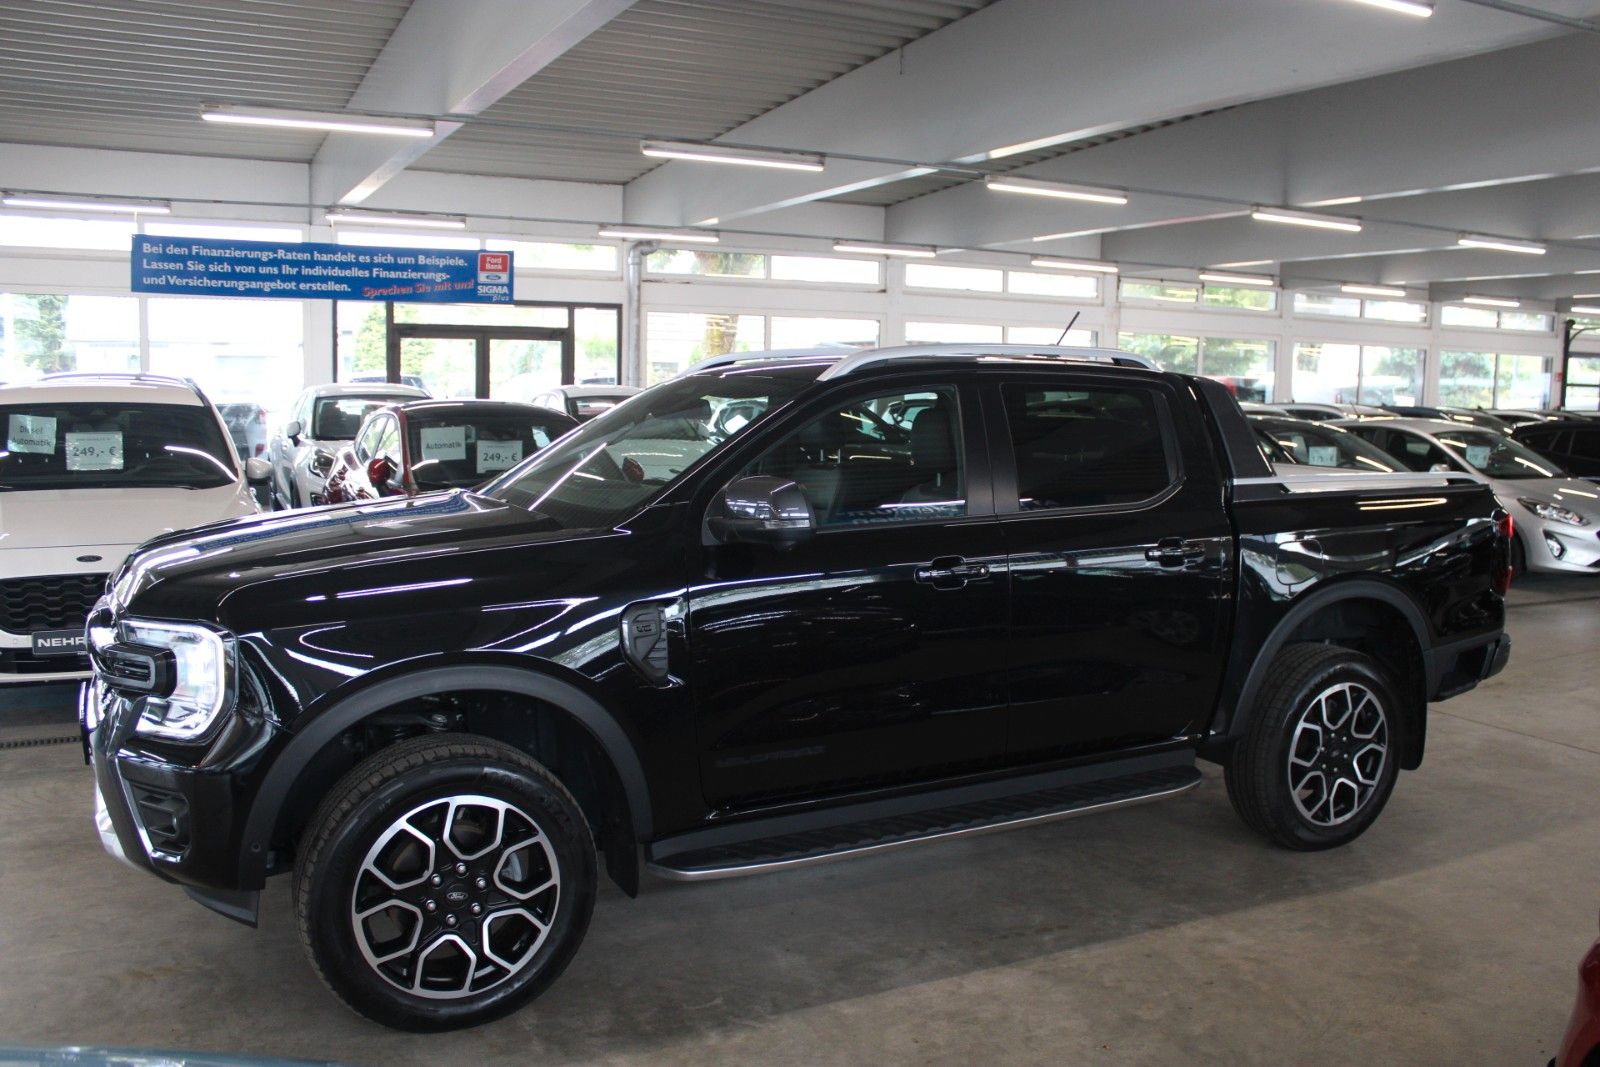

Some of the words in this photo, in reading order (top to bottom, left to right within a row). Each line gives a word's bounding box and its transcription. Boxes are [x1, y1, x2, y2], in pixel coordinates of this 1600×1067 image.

[142, 243, 163, 254] Bei
[166, 244, 188, 255] den
[192, 246, 311, 261] Finanzierungs-Raten
[314, 251, 356, 262] handelt
[359, 255, 370, 263] es
[373, 254, 394, 264] sich
[398, 256, 414, 265] um
[418, 255, 468, 268] Beispiele.
[143, 259, 184, 270] Lassen
[186, 261, 205, 271] Sie
[209, 262, 231, 272] sich
[234, 266, 255, 274] von
[259, 266, 278, 274] uns
[282, 265, 298, 275] Ihr
[301, 265, 370, 277] individuelles
[372, 268, 450, 282] Finanzierungs-
[143, 275, 166, 285] und
[166, 276, 296, 292] Versicherungsangebot
[300, 281, 351, 292] erstellen.
[434, 283, 452, 292] mit
[478, 285, 509, 294] SIGMA
[12, 434, 51, 447] Automatik
[426, 441, 462, 450] Automatik
[108, 446, 116, 456] €
[511, 453, 518, 462] €
